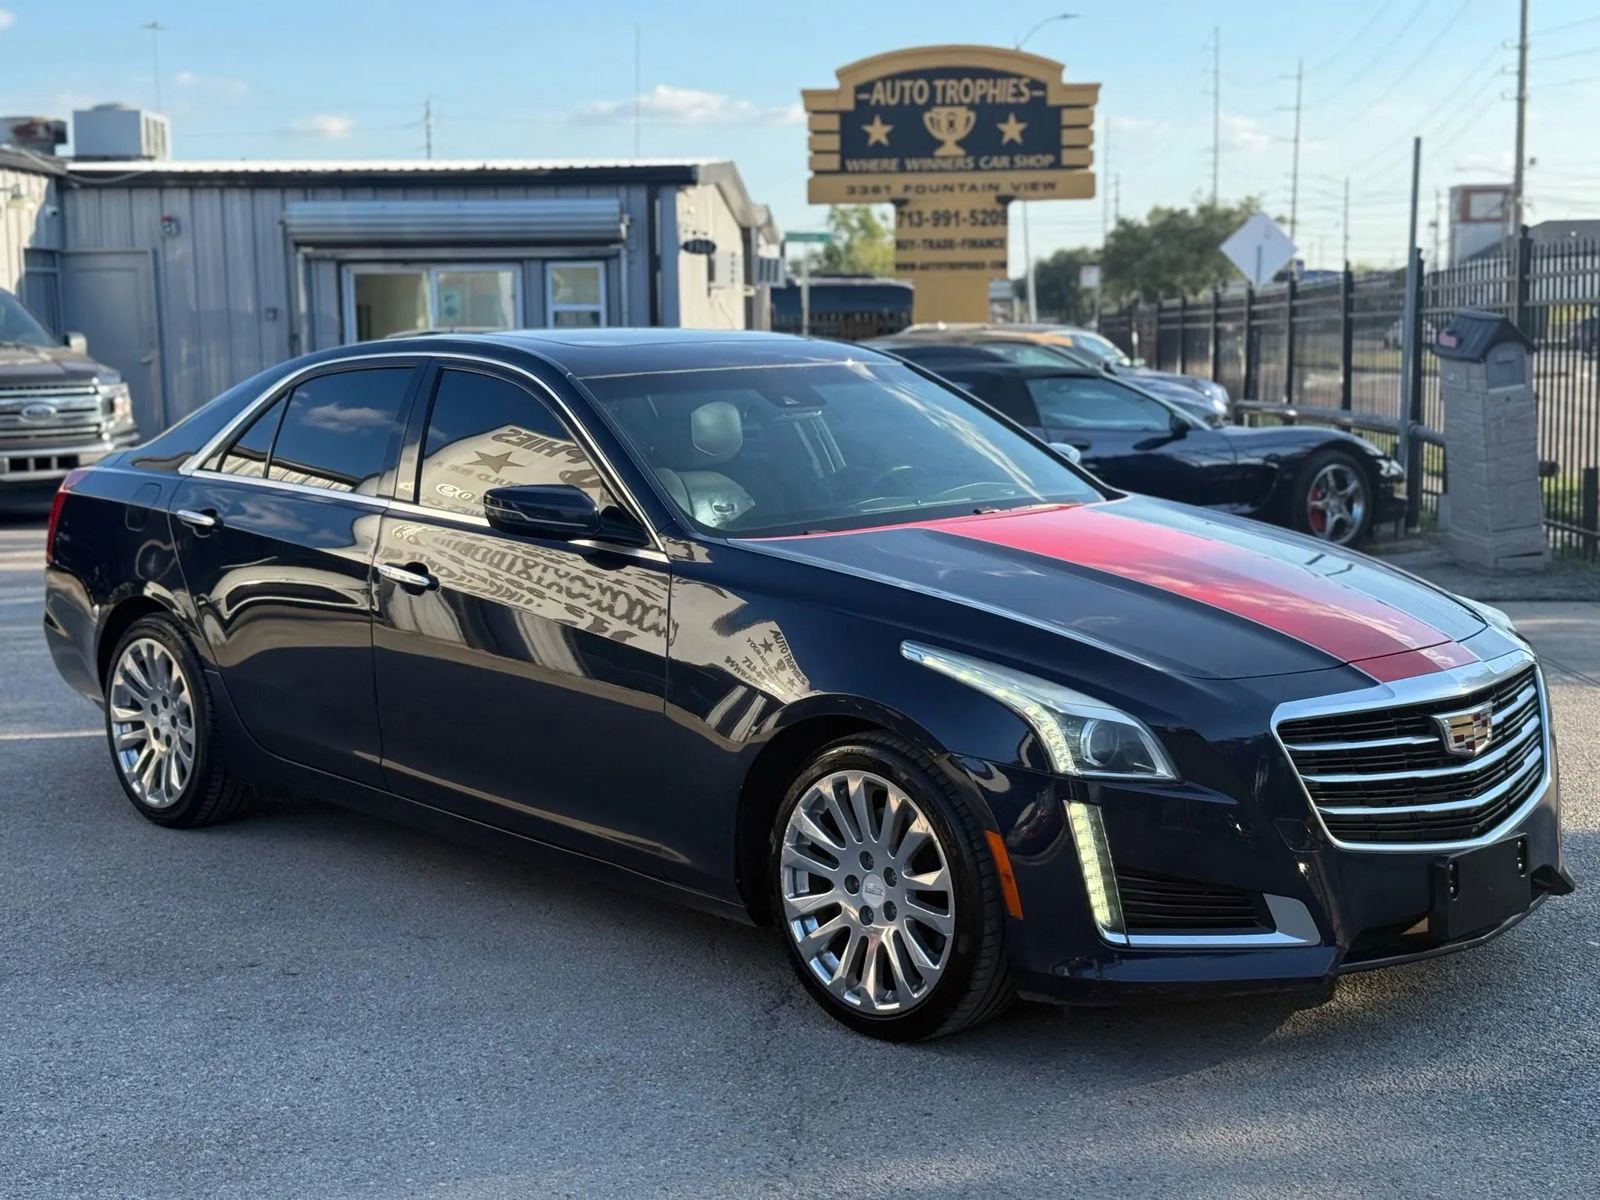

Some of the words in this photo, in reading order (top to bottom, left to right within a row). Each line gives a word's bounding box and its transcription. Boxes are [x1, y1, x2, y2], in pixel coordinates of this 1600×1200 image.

[845, 158, 900, 173] WHERE
[905, 156, 975, 171] WINNERS
[979, 155, 1010, 170] CAR
[1013, 154, 1055, 169] SHOP
[903, 182, 1000, 195] FOUNTAIN
[1011, 181, 1058, 192] VIEW
